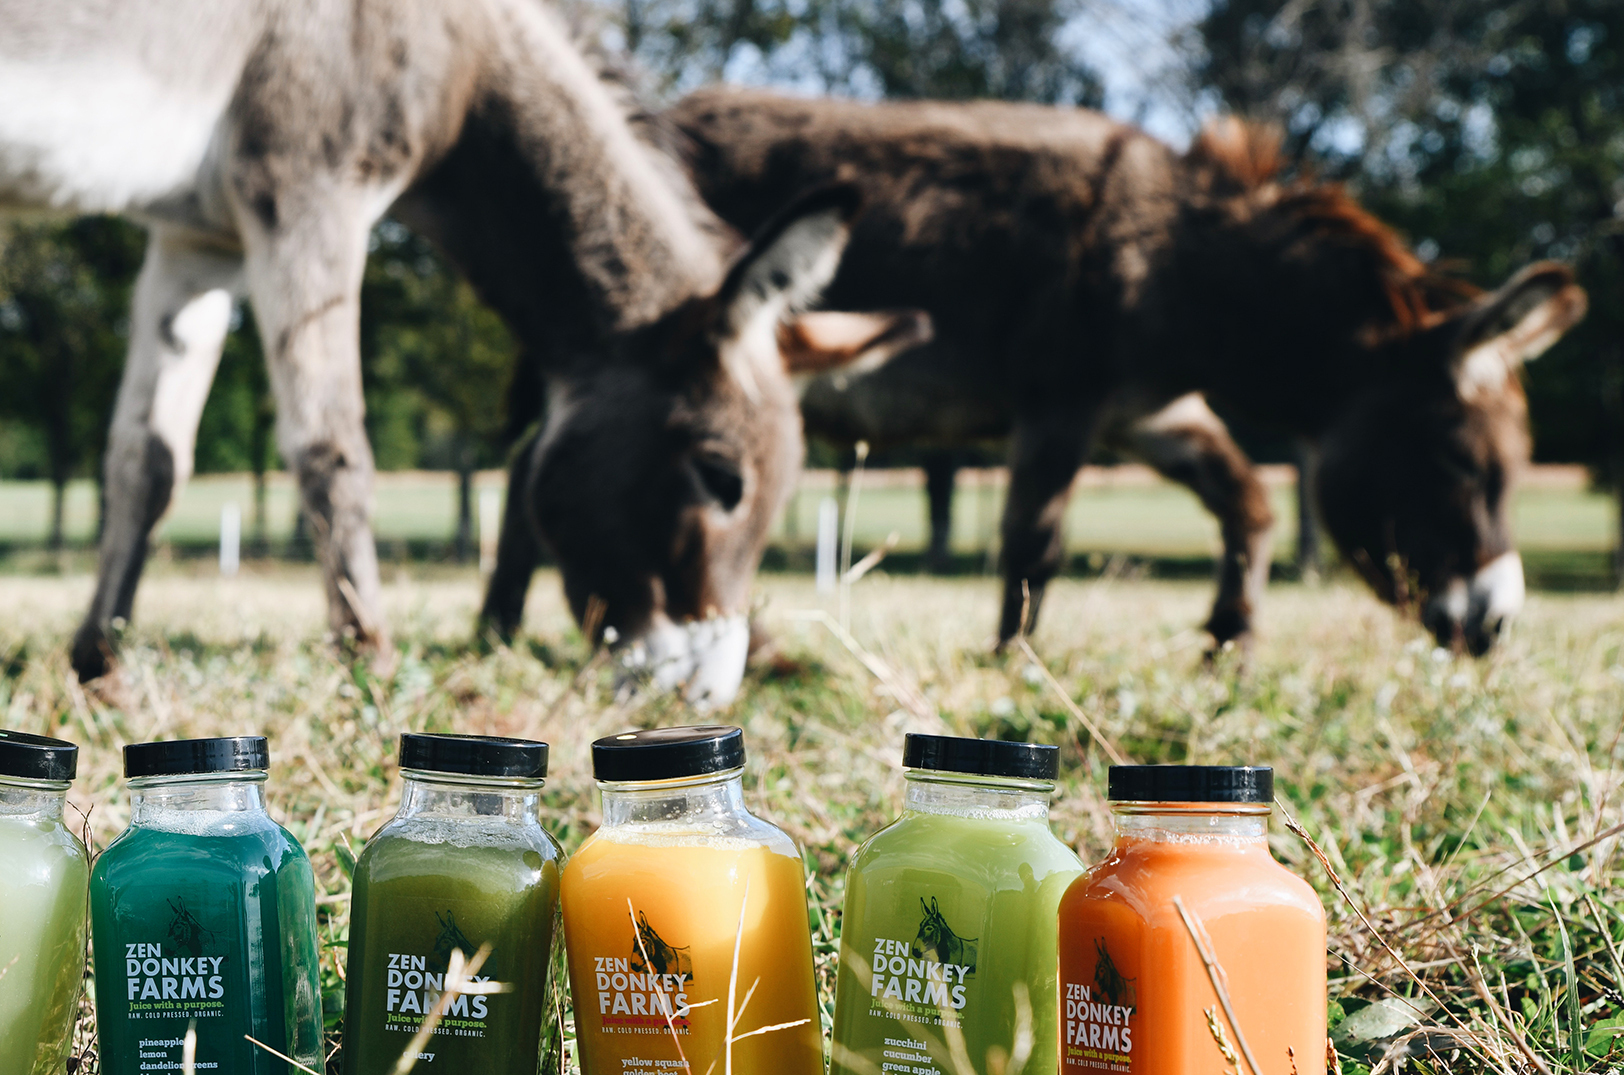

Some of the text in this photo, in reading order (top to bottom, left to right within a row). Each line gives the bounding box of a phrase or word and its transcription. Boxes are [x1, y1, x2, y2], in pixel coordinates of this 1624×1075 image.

[126, 943, 161, 958] ZEN
[874, 938, 909, 957] ZEN
[126, 957, 224, 976] DONKEY
[387, 954, 426, 970] ZEN
[594, 957, 628, 972] ZEN
[873, 954, 970, 984] DONKEY
[128, 976, 224, 1000] FARMS
[596, 973, 687, 992] DONKEY
[871, 974, 966, 1009] FARMS
[1066, 983, 1090, 1001] ZEN
[130, 1002, 152, 1011] Juice
[154, 1001, 174, 1009] with
[184, 1001, 224, 1010] purpose.
[387, 988, 488, 1018] FARMS
[599, 992, 690, 1016] FARMS
[871, 998, 893, 1009] Juice
[896, 1002, 915, 1012] with
[194, 1010, 224, 1018] ORGANIC.
[869, 1009, 963, 1029] RAW. COLD PRESSED. ORGANIC.
[1067, 1000, 1132, 1026] DONKEY
[387, 1014, 411, 1023] Juice
[413, 1016, 434, 1024] wit
[445, 1019, 487, 1028] purpose.
[602, 1016, 623, 1026] Juice
[625, 1017, 644, 1025] with
[455, 1029, 486, 1038] ORGANIC.
[1067, 1021, 1132, 1053] FARMS
[139, 1037, 184, 1048] pineapple
[884, 1038, 926, 1050] zucchini
[140, 1050, 167, 1058] lemon
[403, 1050, 435, 1062] clery
[883, 1050, 932, 1063] cucumber
[1068, 1046, 1082, 1056] Juice
[1084, 1049, 1097, 1058] with
[622, 1057, 690, 1069] yellow squash
[882, 1062, 910, 1073] green
[912, 1067, 940, 1075] apple
